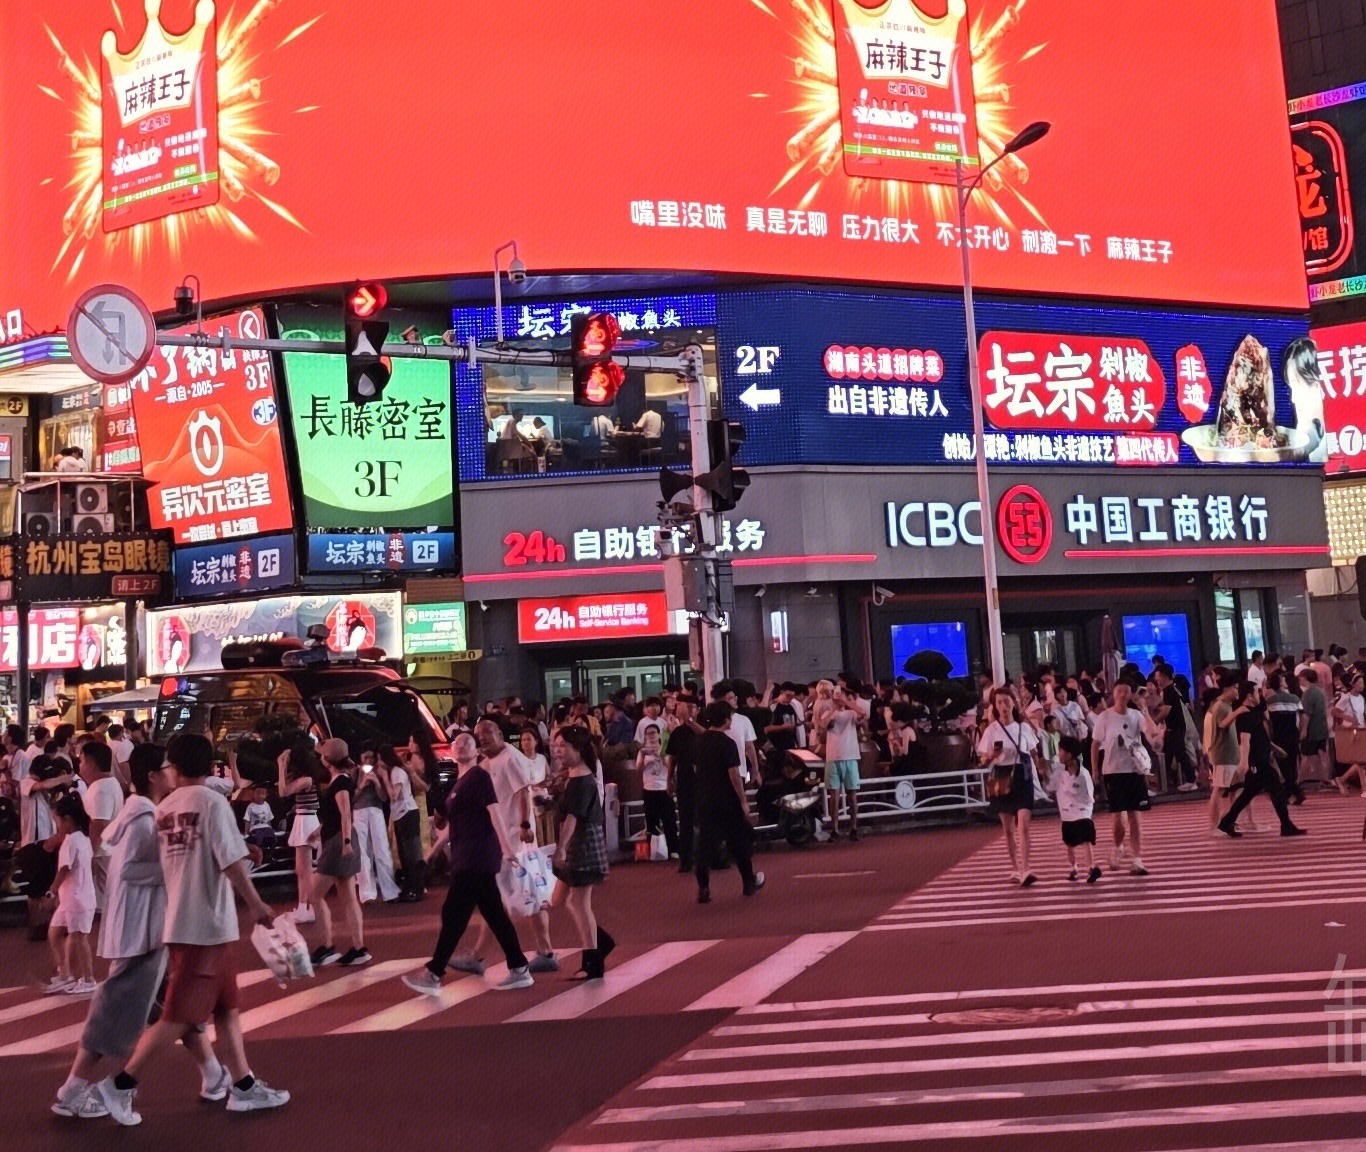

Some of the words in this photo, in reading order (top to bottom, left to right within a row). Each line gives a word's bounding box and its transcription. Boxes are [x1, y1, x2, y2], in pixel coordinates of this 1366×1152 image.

[865, 37, 947, 80] 麻辣王子
[123, 68, 191, 116] 麻辣王子
[630, 200, 727, 231] 嘴里没味
[745, 207, 828, 238] 真是无聊
[841, 214, 920, 245] 压力很大
[1021, 228, 1092, 258] 刺激一下
[1107, 236, 1173, 264] 麻辣王子
[244, 362, 271, 391] 3F
[736, 345, 780, 375] 2F
[826, 348, 944, 378] 湖南头道招牌菜
[986, 342, 1096, 423] 坛宗
[1099, 345, 1153, 383] 剁椒
[1179, 355, 1211, 413] 非遗
[253, 400, 277, 424] 3F
[828, 385, 949, 418] 出自非遗传人
[160, 471, 273, 522] 异次元密室
[354, 460, 403, 498] 3F
[885, 500, 984, 548] ICBC
[1065, 493, 1269, 546] 中国工商银行
[25, 538, 172, 576] 杭州宝岛眼镜
[325, 539, 366, 566] 坛宗
[416, 543, 436, 560] 2F
[503, 529, 566, 566] 24h
[190, 556, 221, 586] 坛宗
[260, 551, 277, 574] 2F
[534, 606, 576, 631] 24h
[578, 602, 649, 619] 自助银行服务
